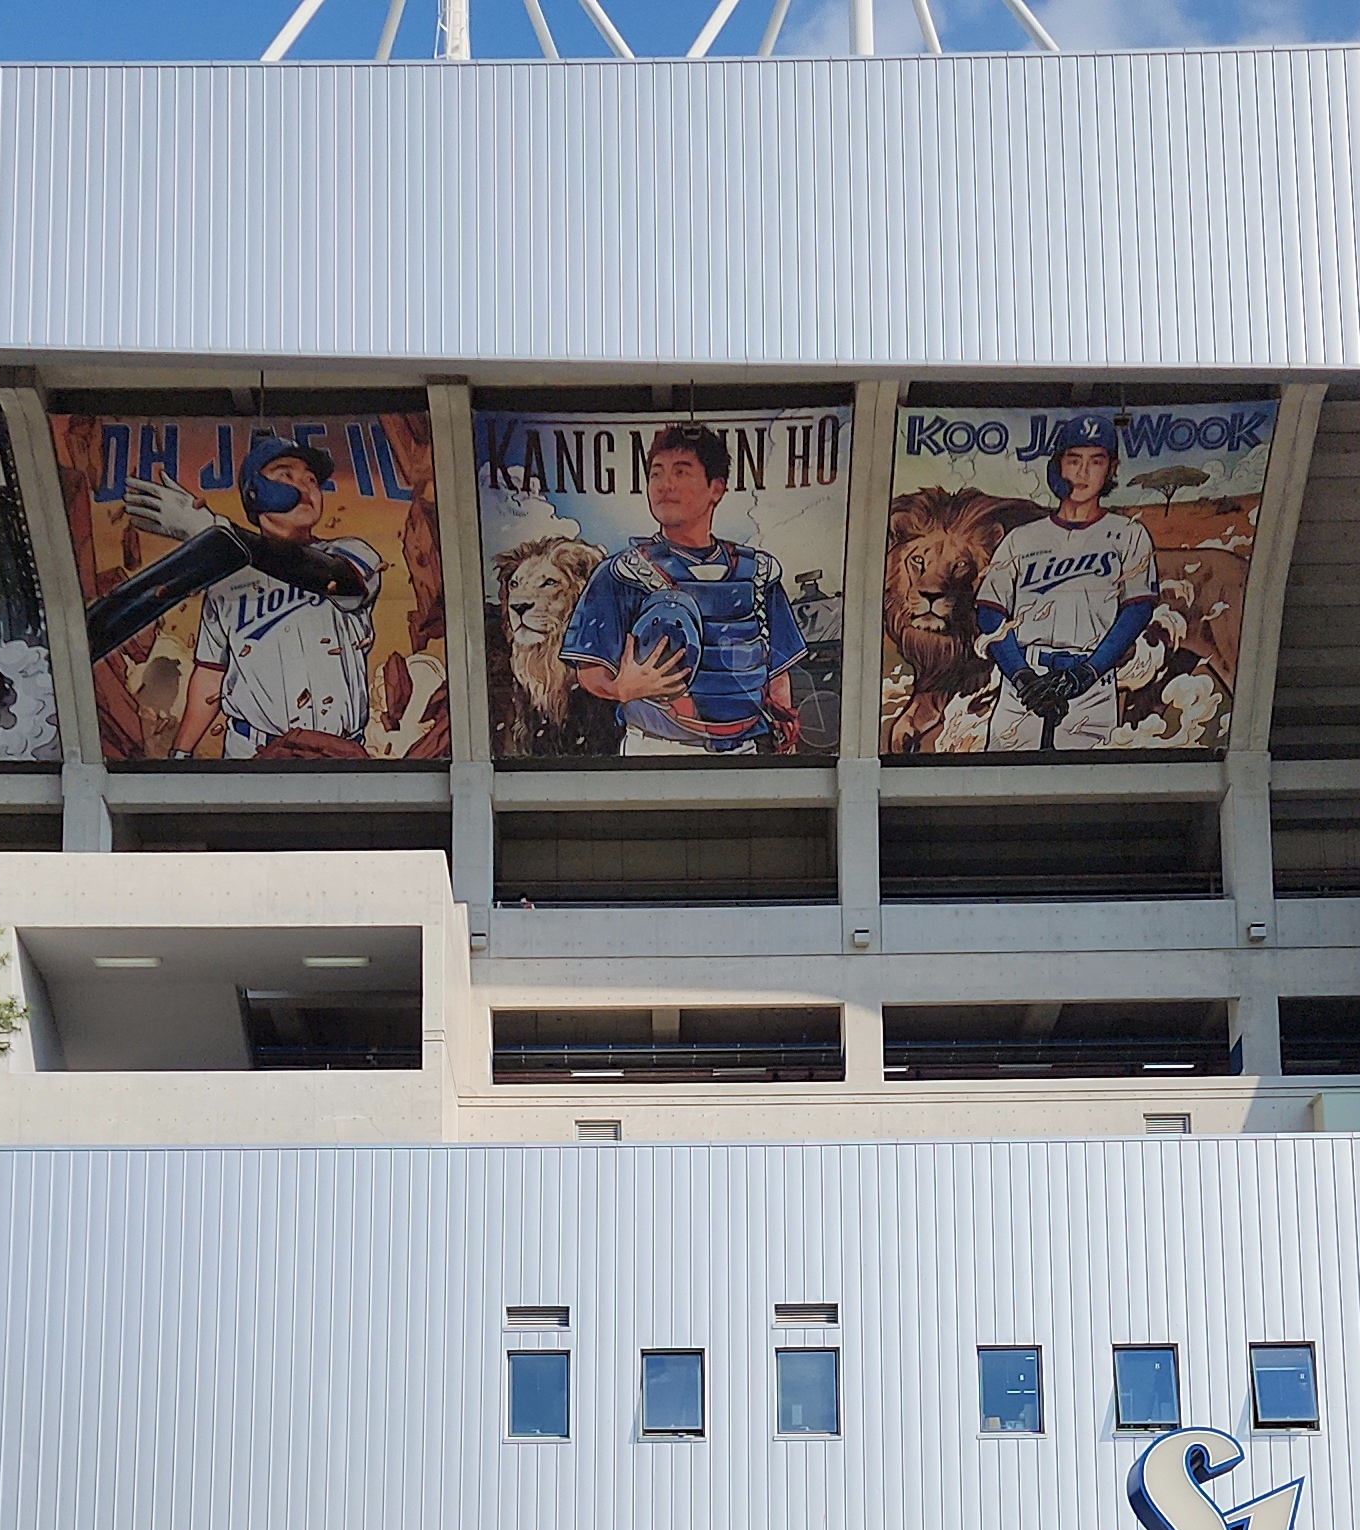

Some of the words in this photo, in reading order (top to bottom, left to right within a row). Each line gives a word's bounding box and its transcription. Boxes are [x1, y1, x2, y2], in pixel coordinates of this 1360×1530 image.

[484, 420, 616, 495] KANG
[785, 415, 840, 488] HO
[907, 415, 1009, 456] KOO
[1122, 412, 1267, 458] WOOK
[1020, 551, 1117, 589] Lions
